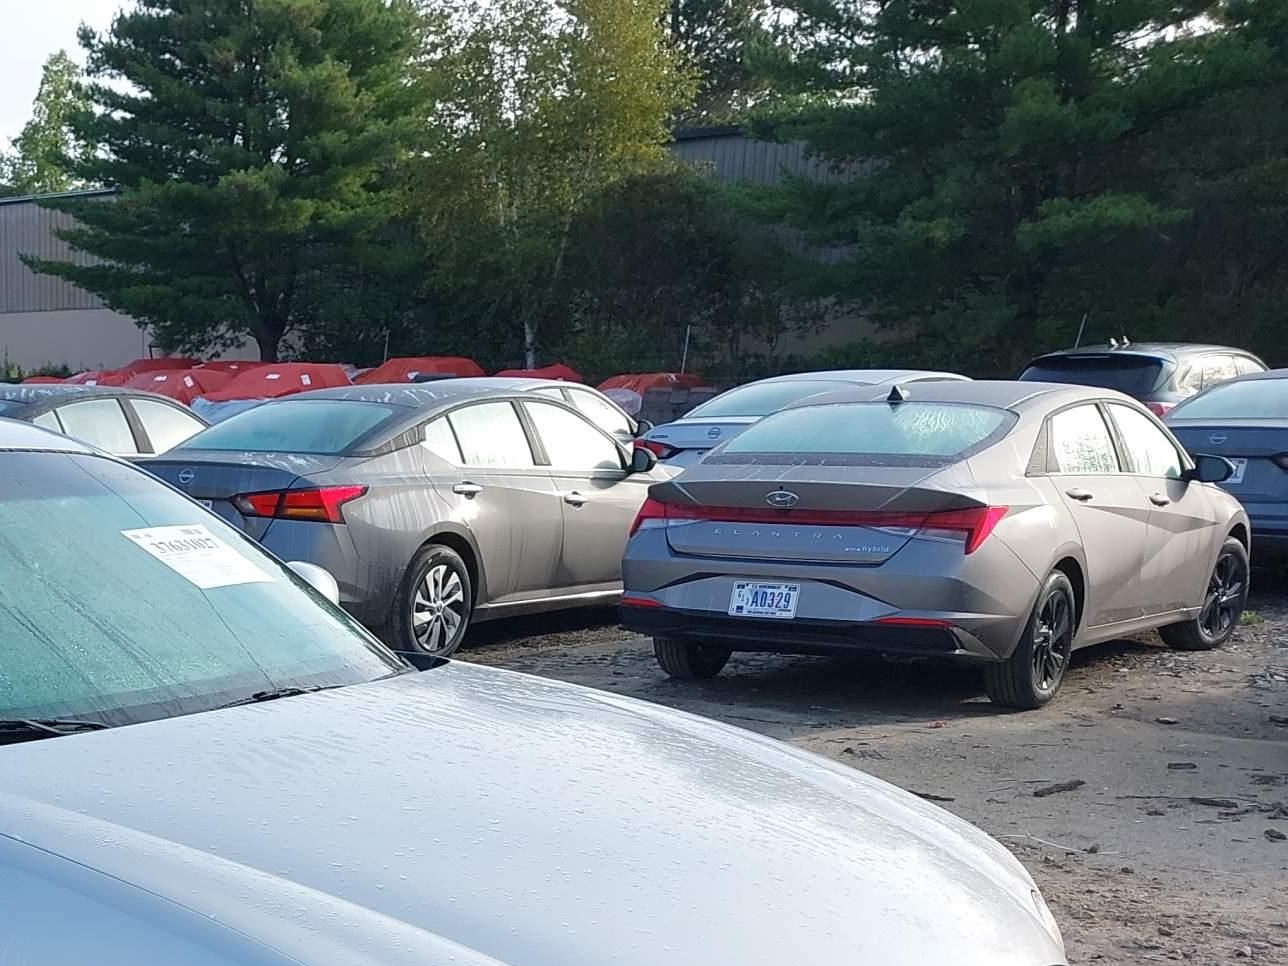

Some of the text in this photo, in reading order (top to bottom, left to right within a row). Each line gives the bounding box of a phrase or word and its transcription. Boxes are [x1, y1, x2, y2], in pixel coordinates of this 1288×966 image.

[714, 528, 842, 540] ELANTRA
[150, 538, 220, 553] 37631027
[862, 545, 889, 553] hybrid
[750, 590, 791, 609] A0329
